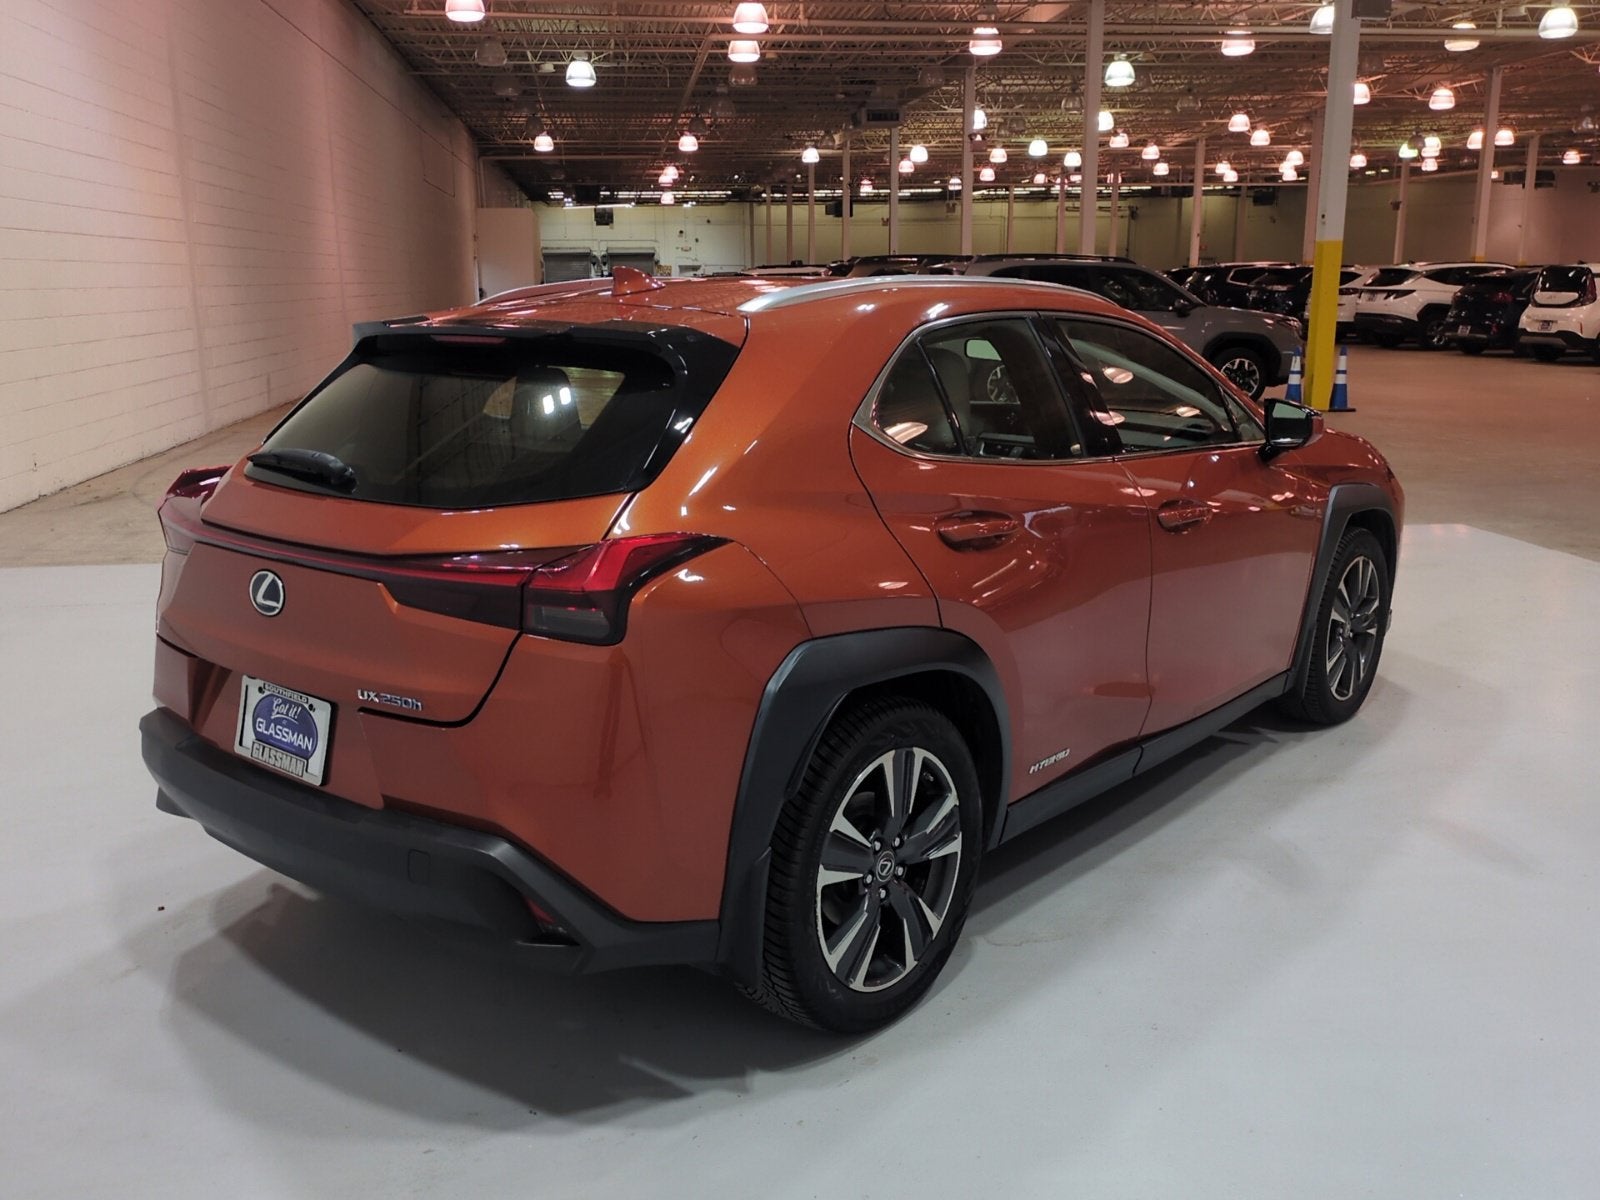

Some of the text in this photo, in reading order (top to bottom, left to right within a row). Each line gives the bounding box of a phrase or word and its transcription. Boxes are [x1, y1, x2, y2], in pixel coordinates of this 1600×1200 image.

[264, 682, 308, 702] SOUTHFIELD
[357, 689, 422, 711] UX 250h
[271, 697, 289, 718] Got
[256, 717, 313, 751] GLASSMAN
[252, 742, 305, 776] GLASSMAN
[1029, 748, 1070, 774] HYBRID
